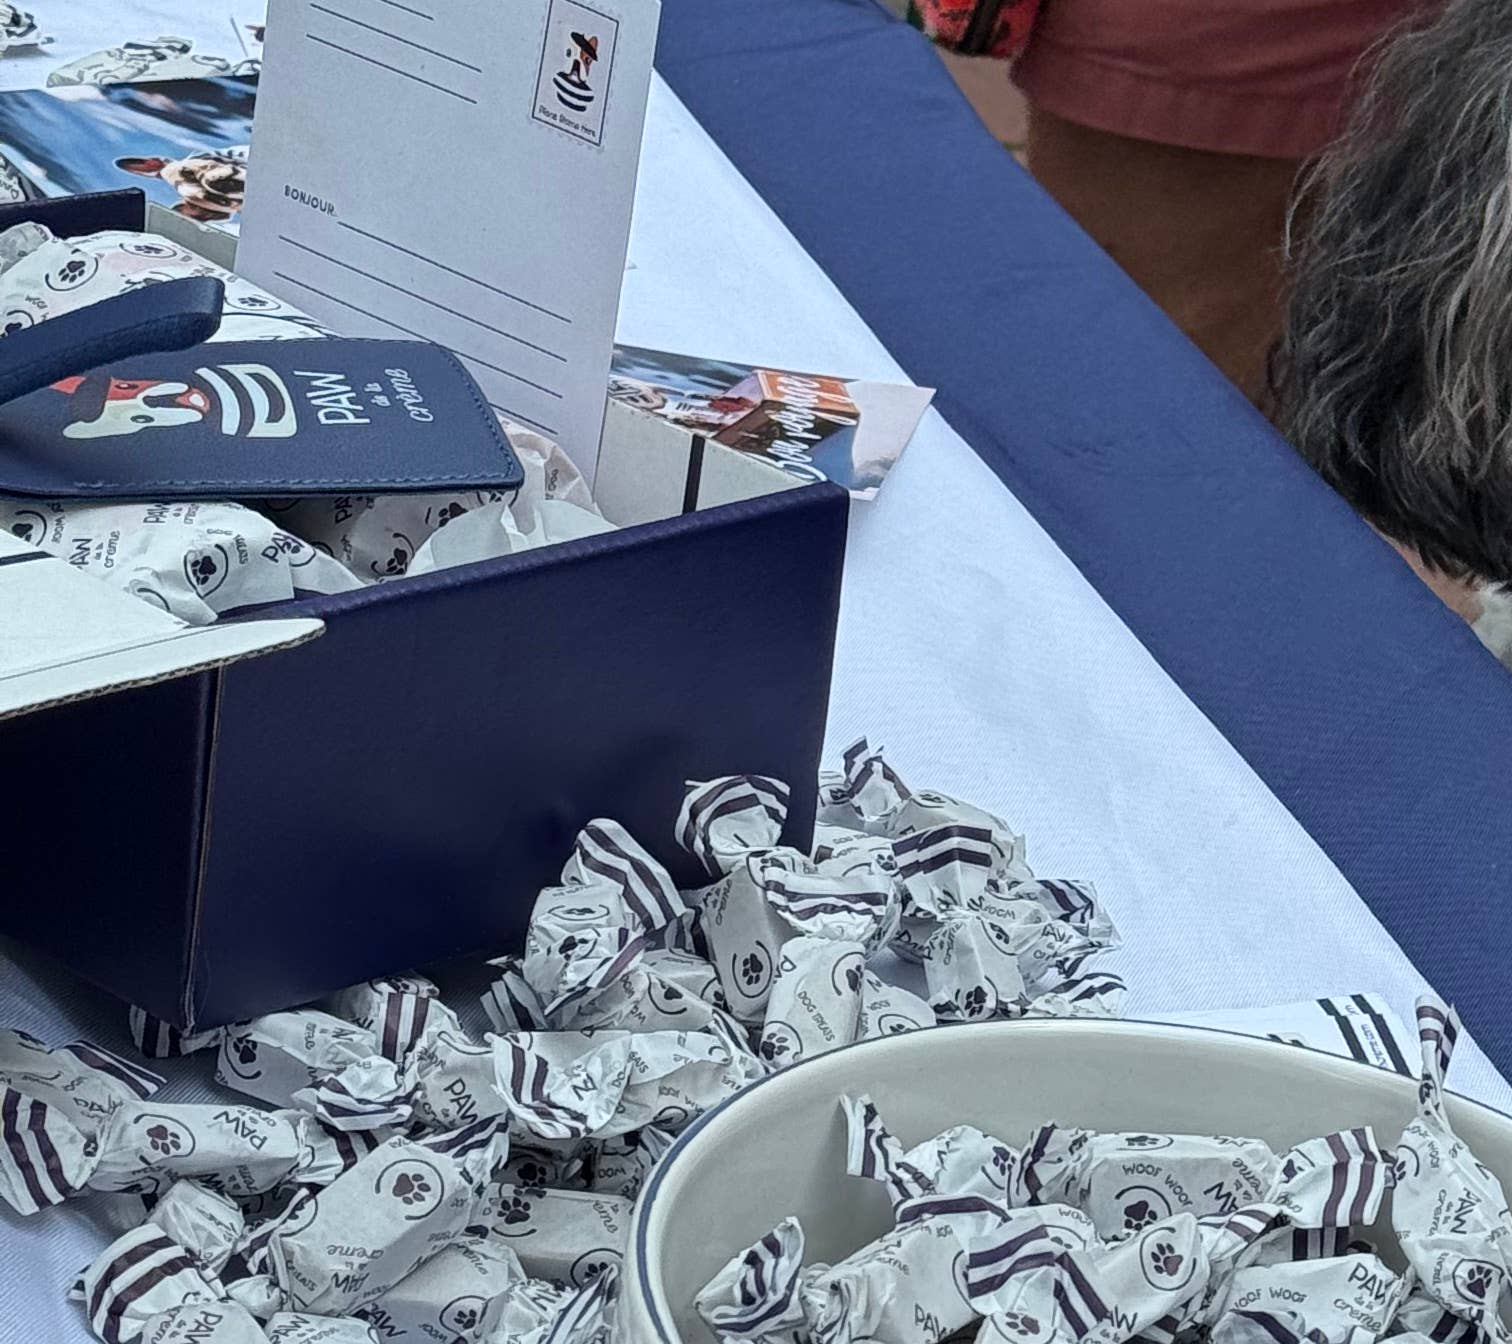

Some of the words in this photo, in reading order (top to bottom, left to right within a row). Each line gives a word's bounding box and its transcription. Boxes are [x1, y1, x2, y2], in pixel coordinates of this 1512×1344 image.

[293, 369, 371, 425] PAW
[69, 538, 92, 570] AW
[212, 1109, 269, 1152] PAW
[1122, 1162, 1163, 1178] WOOF
[1163, 1173, 1193, 1208] WOOF
[1231, 1157, 1264, 1197] reme
[1203, 1181, 1240, 1212] AW
[326, 1243, 385, 1261] creme
[1268, 1286, 1307, 1304] WOOF
[1333, 1297, 1383, 1333] creme
